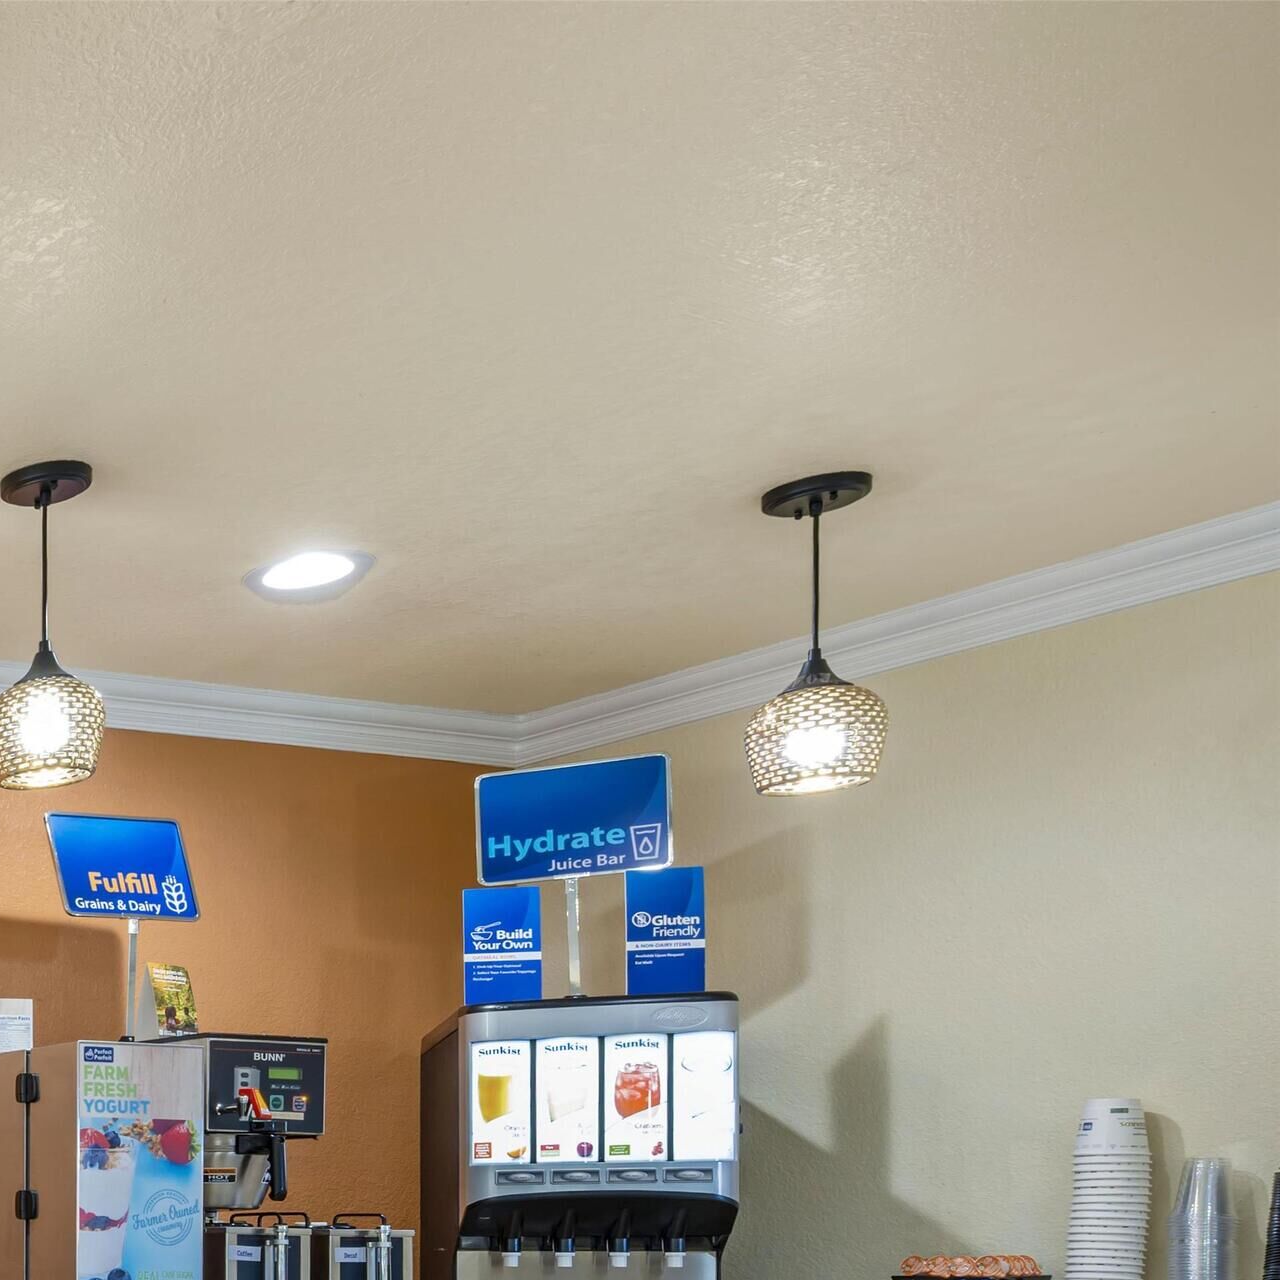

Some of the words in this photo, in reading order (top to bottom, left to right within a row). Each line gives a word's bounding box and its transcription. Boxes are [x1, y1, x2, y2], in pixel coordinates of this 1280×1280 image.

[488, 827, 626, 862] Hydrate
[547, 859, 592, 872] Juice
[596, 853, 626, 867] Bar
[88, 871, 158, 895] Fulfill
[75, 897, 115, 910] Grains
[117, 899, 127, 911] &
[128, 899, 162, 915] Dairy
[651, 914, 700, 926] Gluten
[496, 928, 533, 940] Build
[652, 925, 701, 938] Friendly
[472, 941, 501, 951] Your
[502, 940, 533, 950] Own
[544, 1042, 588, 1053] Sunkist
[614, 1038, 660, 1050] Sunkist
[253, 1052, 284, 1062] BUNN
[478, 1046, 521, 1057] Sunkist
[83, 1065, 129, 1081] FARM
[83, 1082, 137, 1097] FRESH
[83, 1099, 150, 1114] YOGURT
[132, 1212, 169, 1230] Farmer
[169, 1199, 200, 1220] Owned
[236, 1249, 253, 1257] Coffee
[343, 1251, 358, 1259] Decaf
